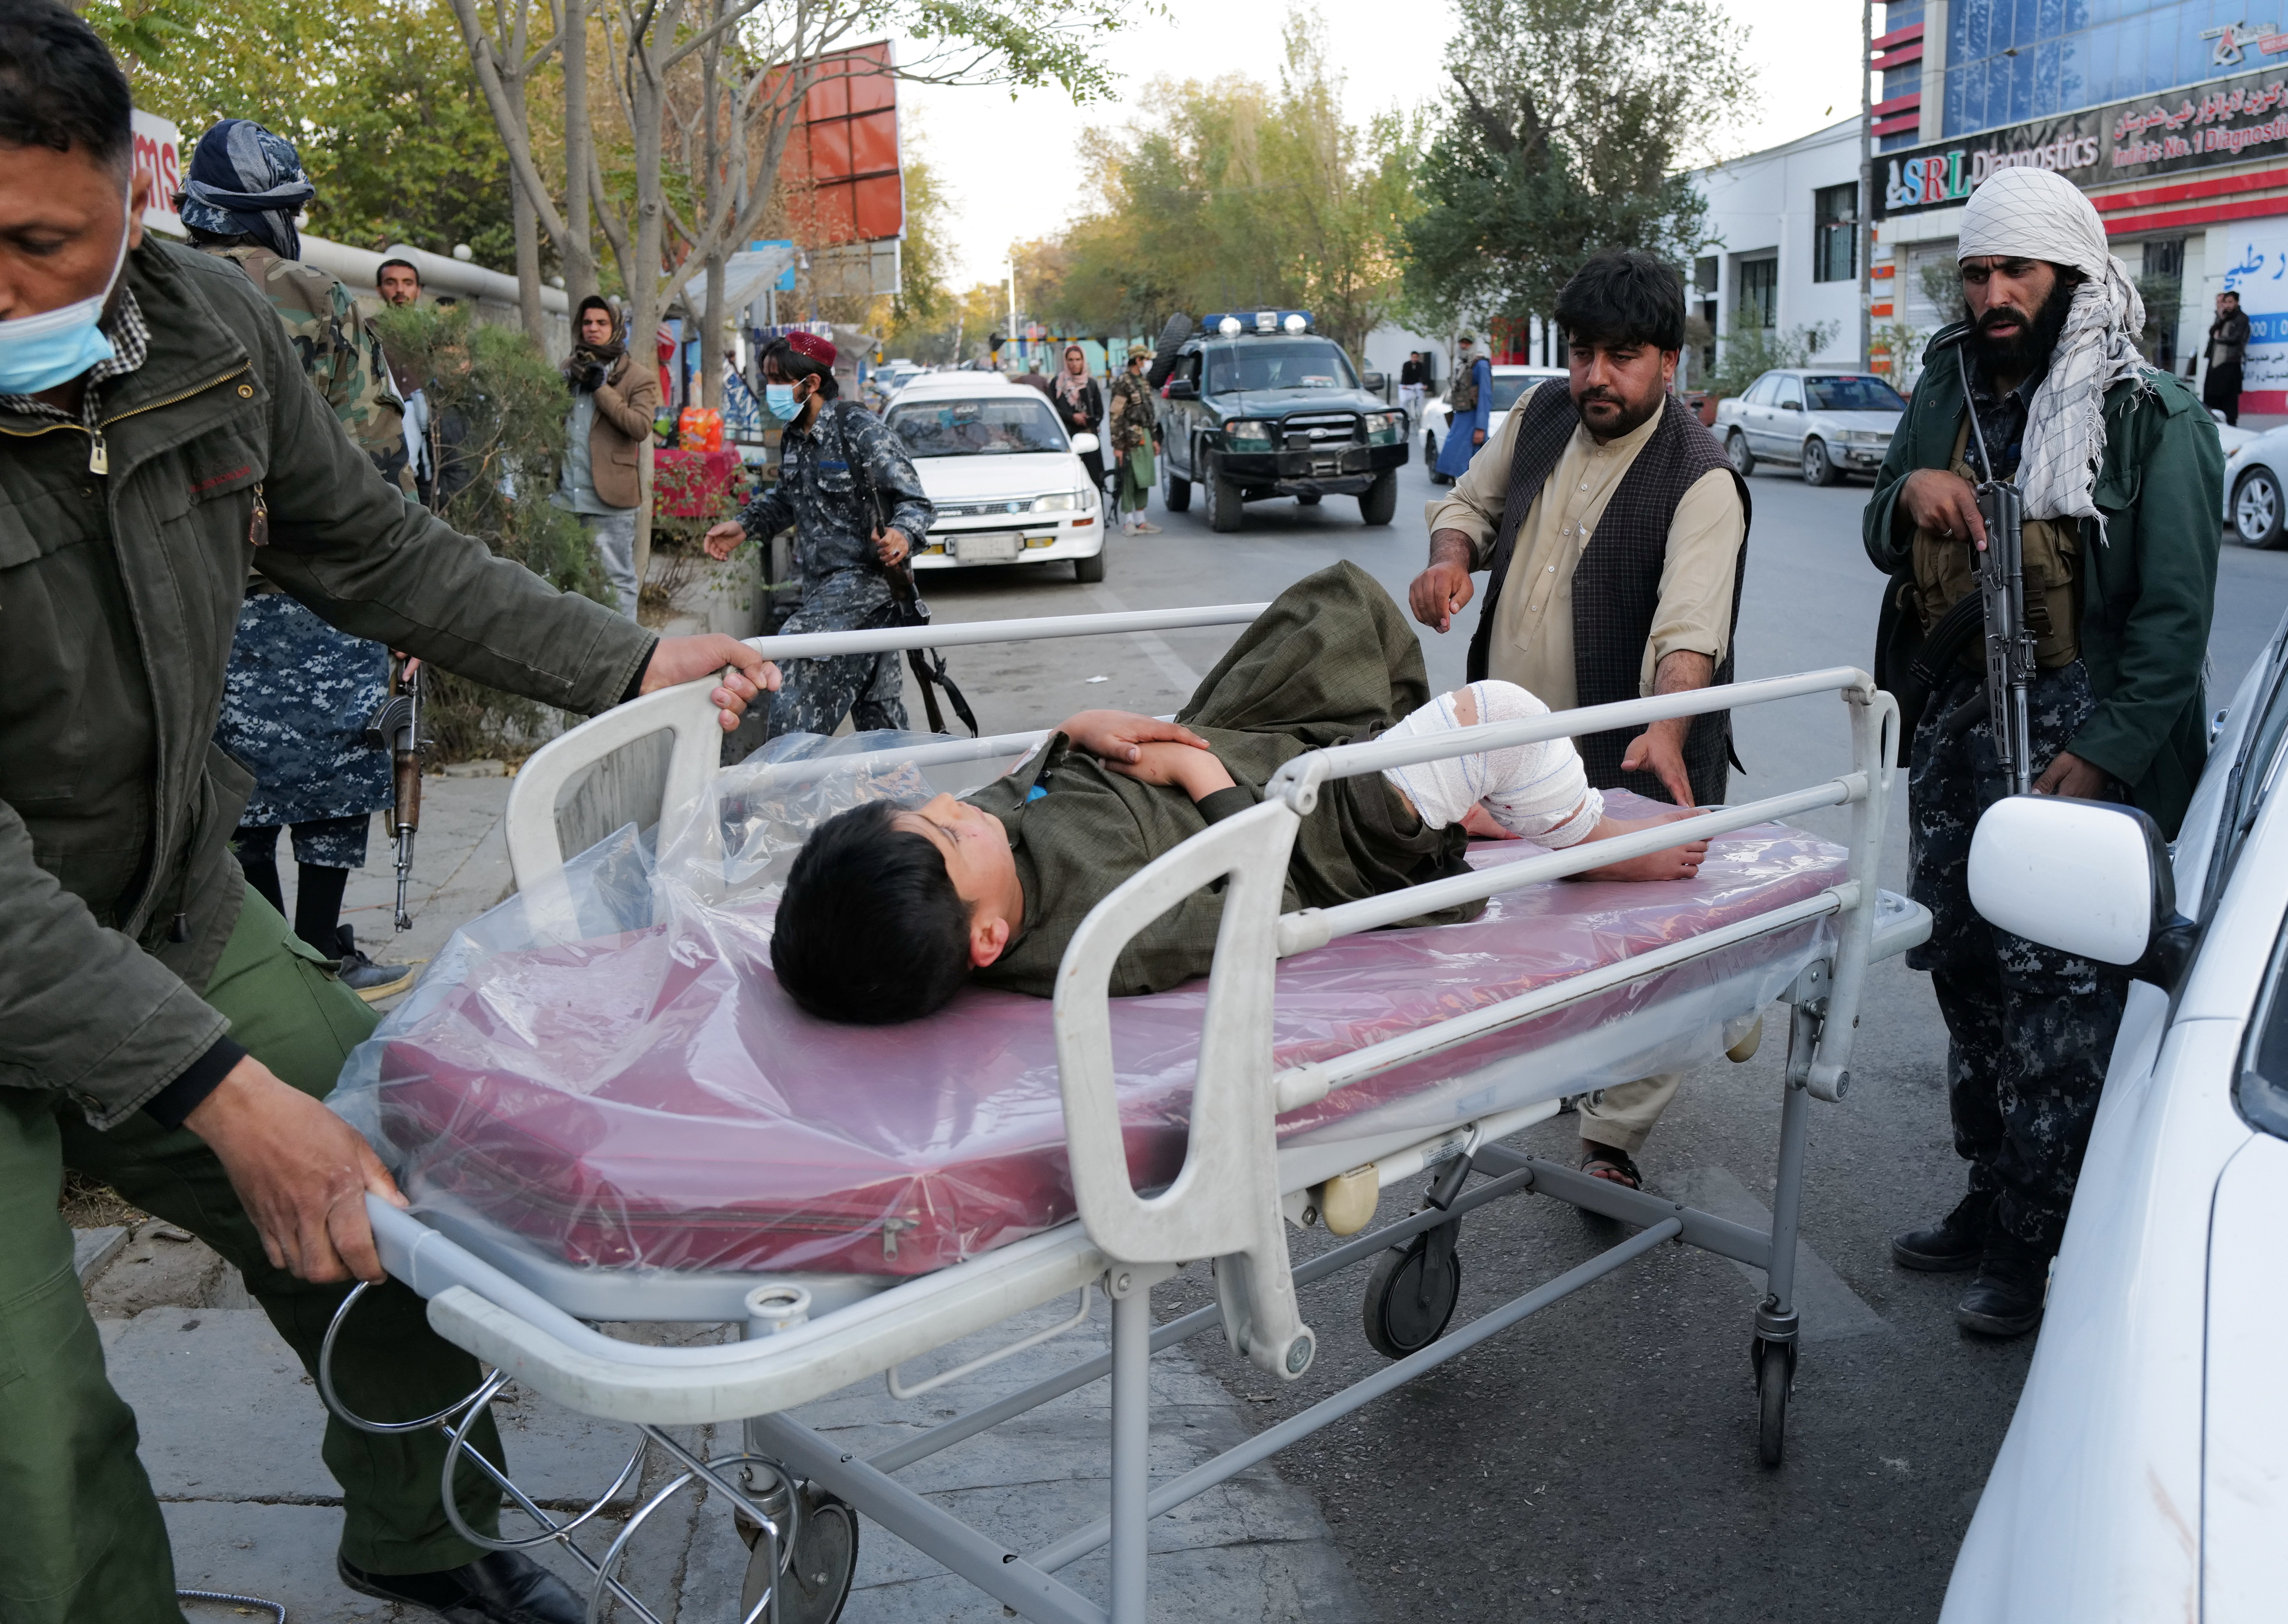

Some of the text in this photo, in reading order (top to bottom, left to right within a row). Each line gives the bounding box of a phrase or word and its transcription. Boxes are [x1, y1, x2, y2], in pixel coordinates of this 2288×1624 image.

[130, 130, 178, 214] ms
[2112, 140, 2163, 168] India's
[2163, 135, 2193, 160] No.
[2192, 130, 2204, 154] 1
[1901, 150, 1973, 206] SRL
